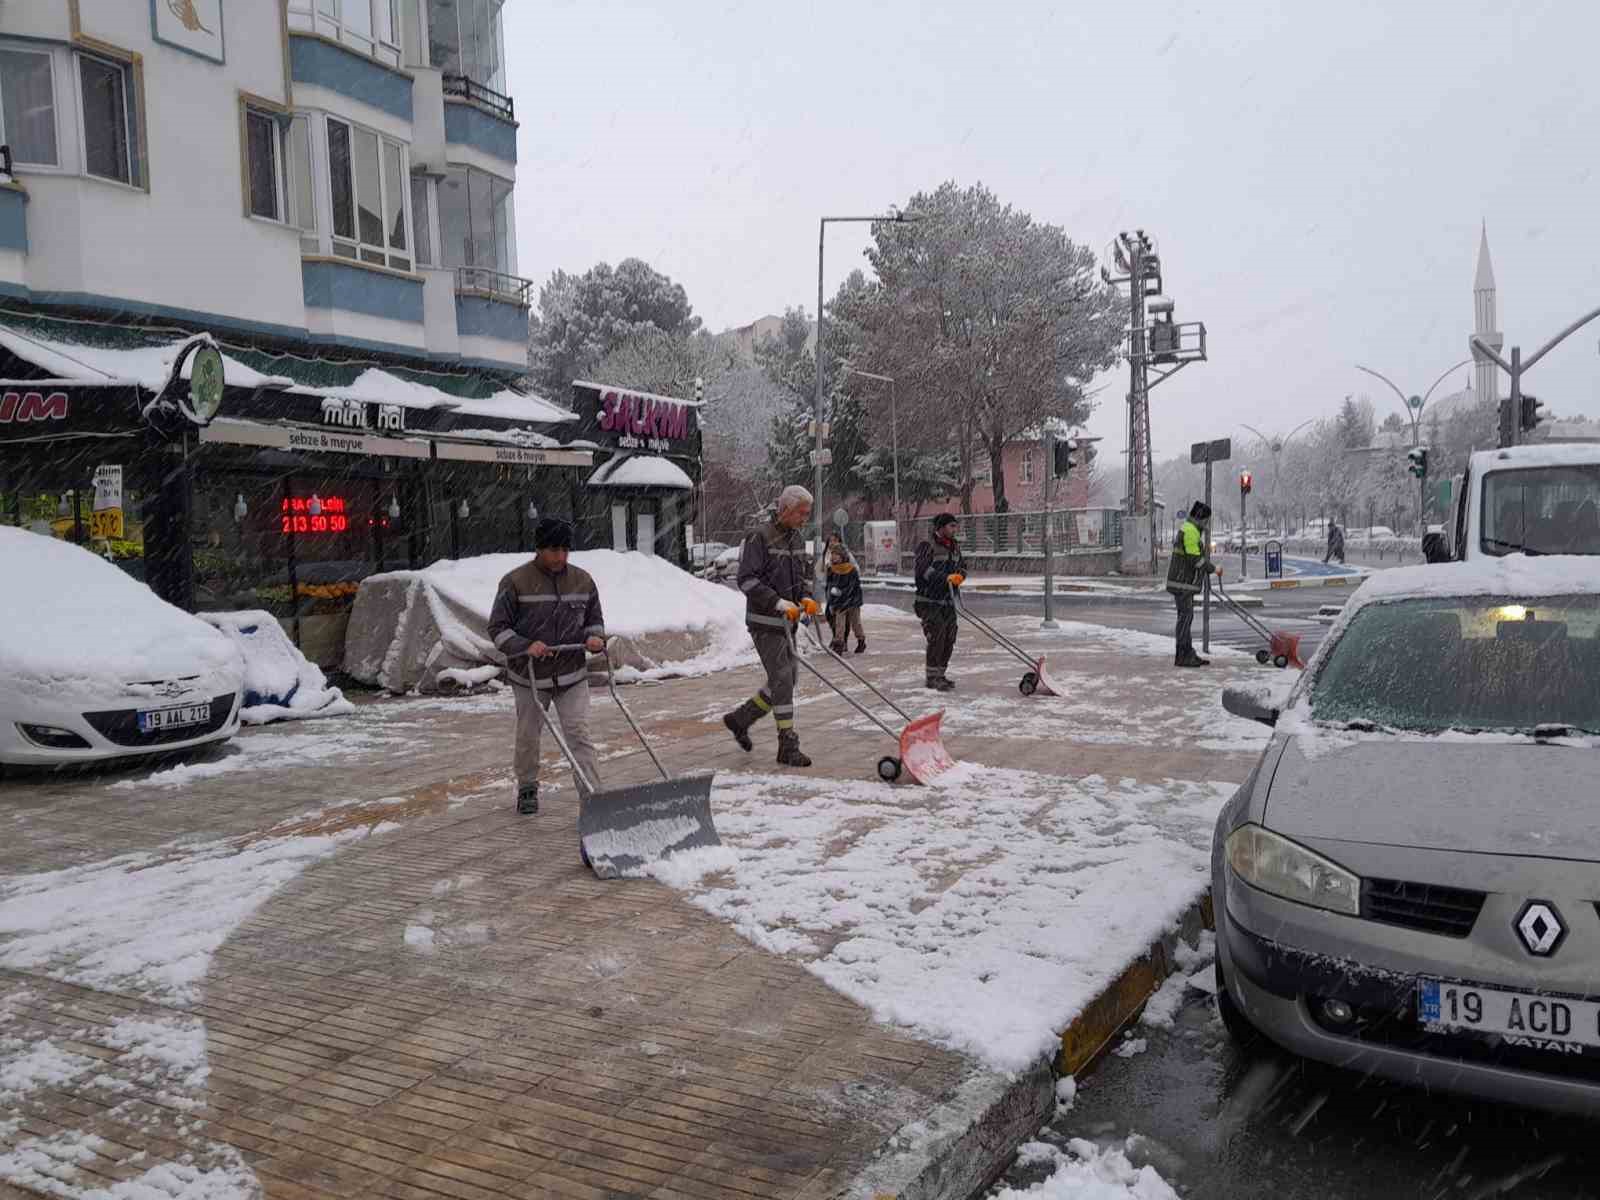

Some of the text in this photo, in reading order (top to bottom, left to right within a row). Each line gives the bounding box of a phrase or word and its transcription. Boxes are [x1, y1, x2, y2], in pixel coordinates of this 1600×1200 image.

[0, 392, 68, 422] IM
[324, 400, 406, 430] mini hal
[289, 432, 319, 446] sebze
[320, 434, 329, 447] &
[282, 515, 346, 533] 213 50 50
[147, 712, 161, 727] 19
[167, 709, 185, 724] AAL
[190, 705, 208, 721] 212
[1425, 1003, 1440, 1014] TR
[1446, 988, 1483, 1023] 19
[1507, 997, 1571, 1036] ACD
[1502, 1033, 1583, 1054] VATAN
